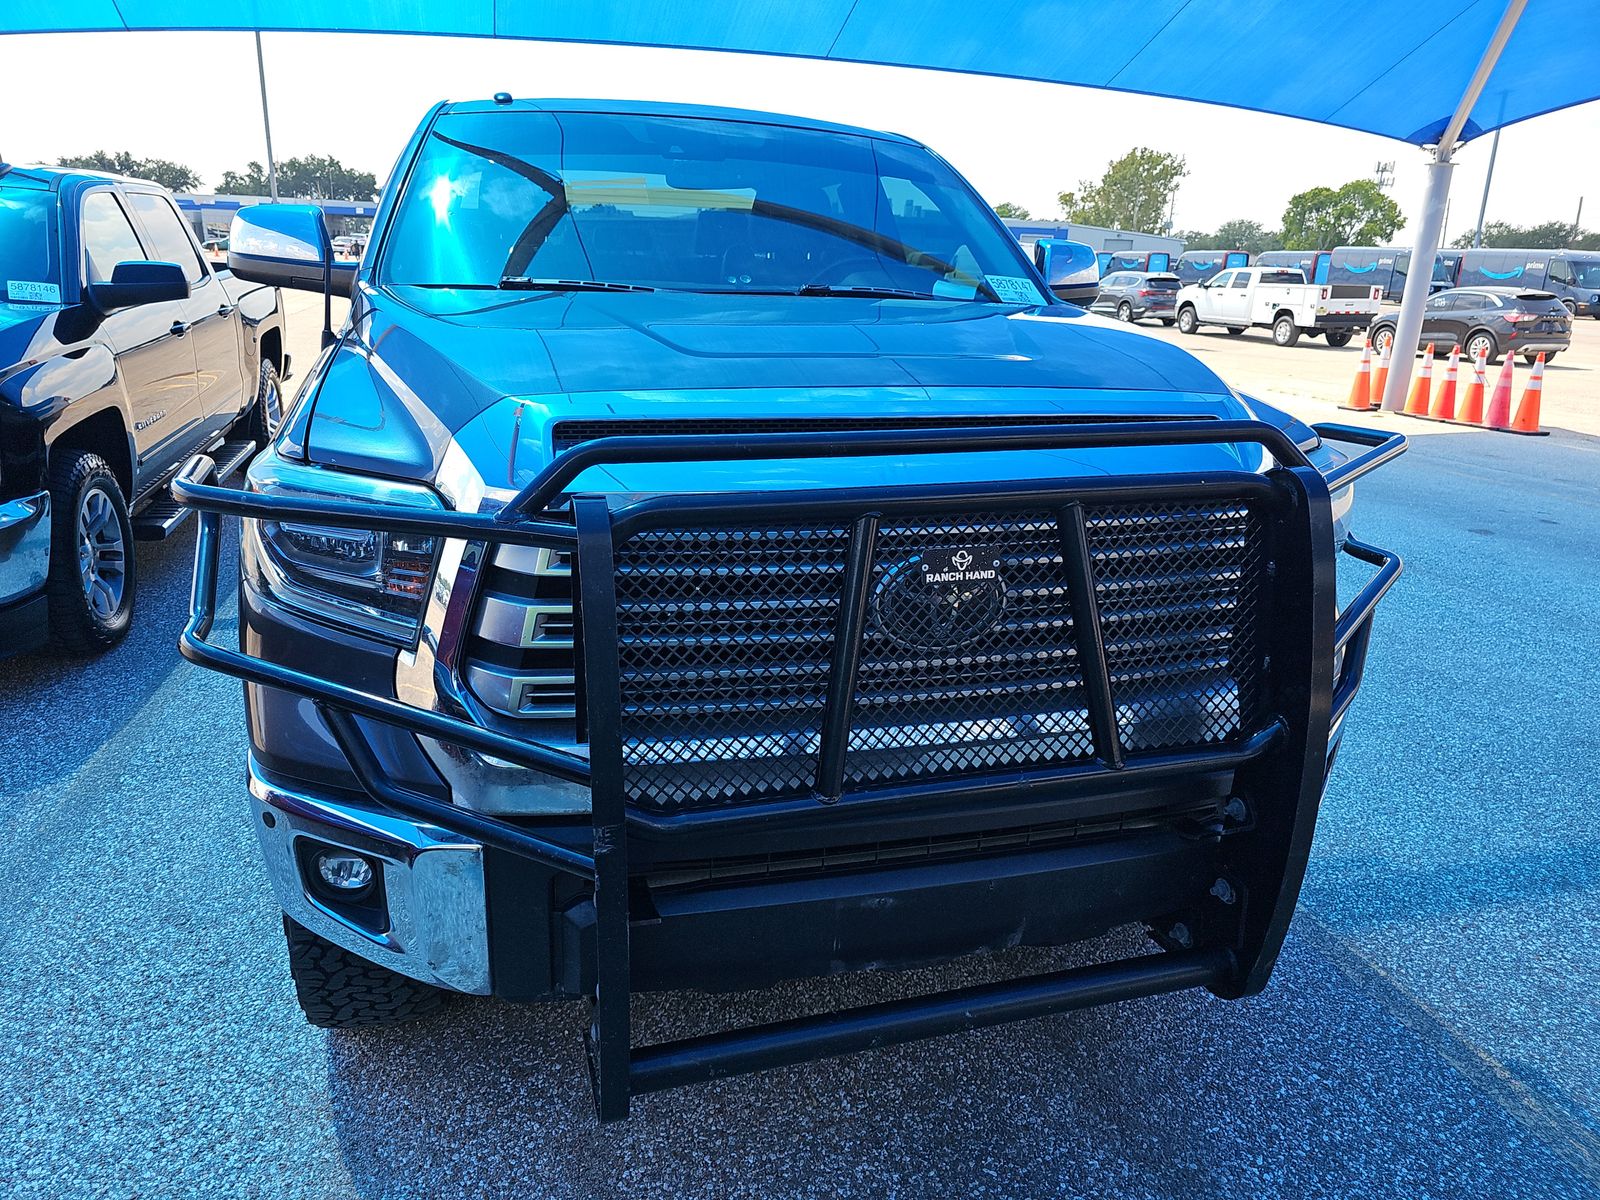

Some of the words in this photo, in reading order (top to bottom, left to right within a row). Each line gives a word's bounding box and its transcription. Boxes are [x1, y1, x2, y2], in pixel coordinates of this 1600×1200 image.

[1525, 261, 1544, 270] prime
[10, 282, 56, 294] 5878146
[990, 278, 1032, 292] 5878147
[926, 572, 963, 583] RANCH
[965, 570, 996, 580] HAND
